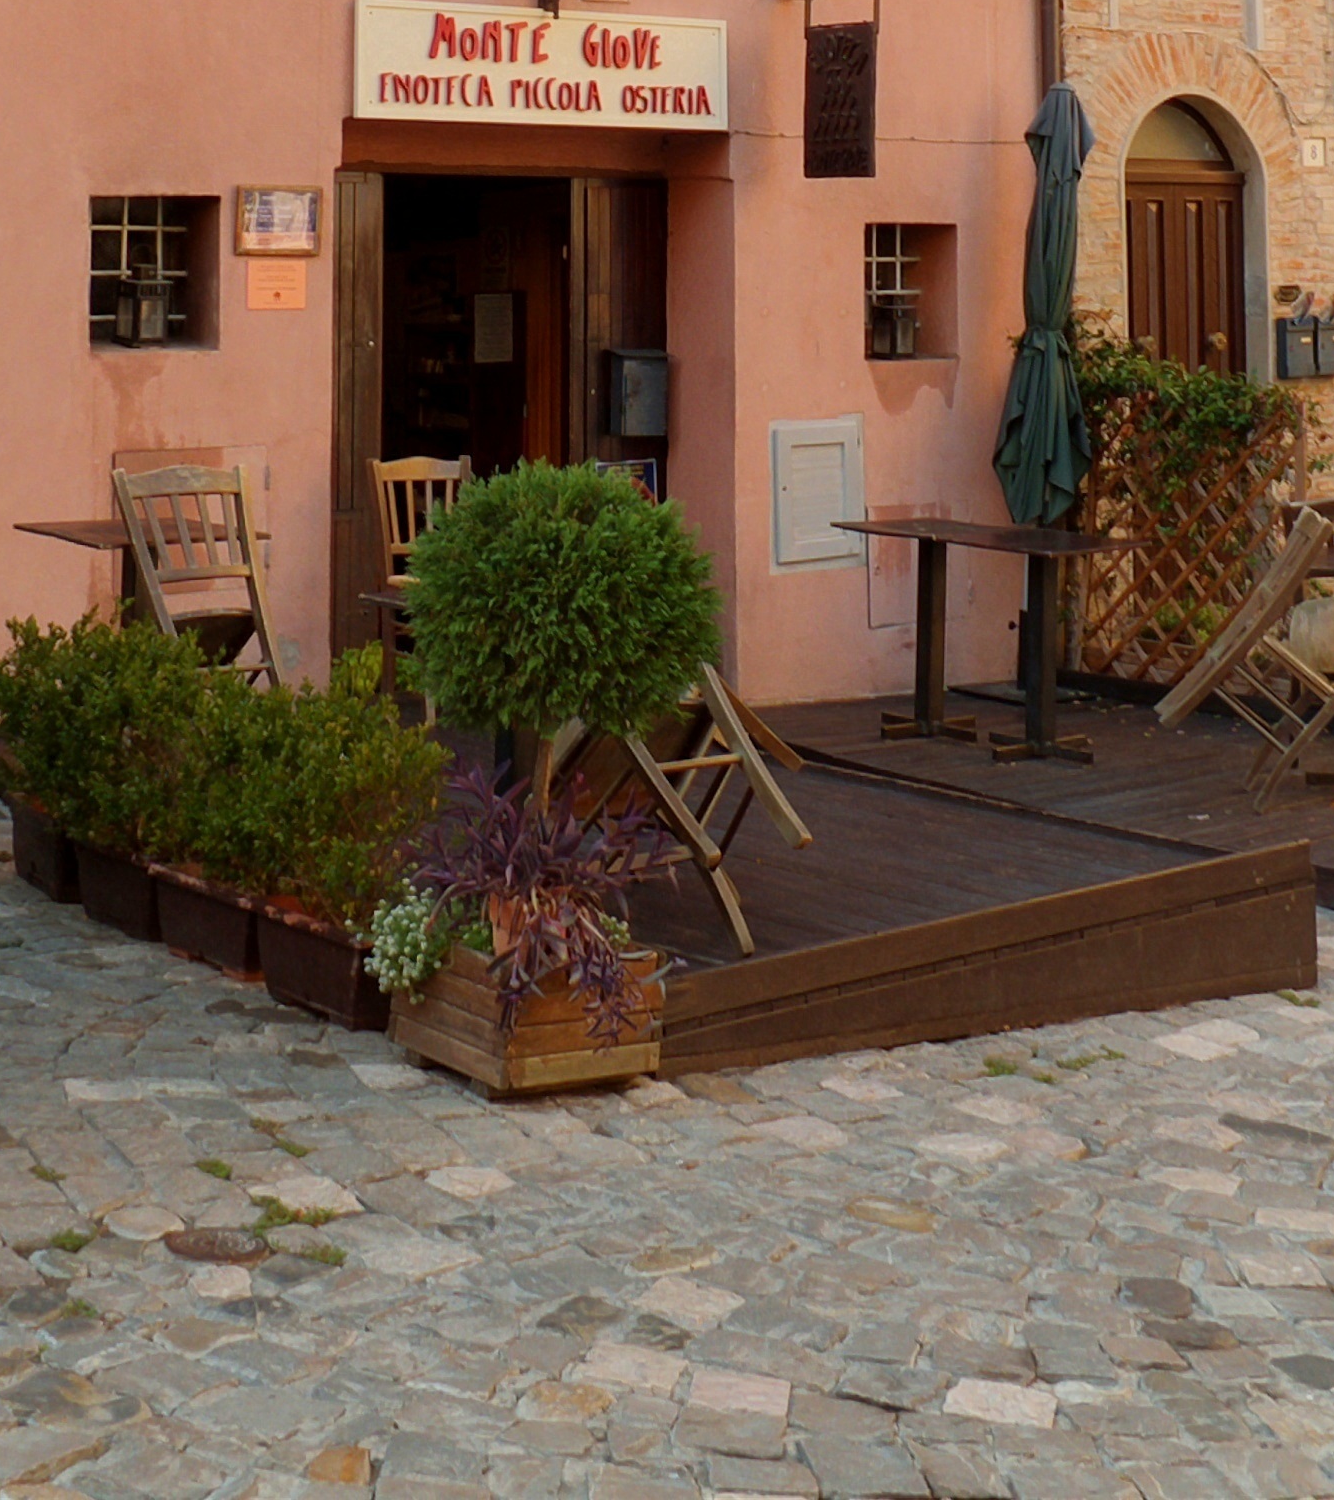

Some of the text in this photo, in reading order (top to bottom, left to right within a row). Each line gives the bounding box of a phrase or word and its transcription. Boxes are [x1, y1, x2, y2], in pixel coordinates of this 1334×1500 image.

[429, 12, 663, 70] MONTE GIOVE
[380, 71, 713, 116] ENOTECA PICCOLA OSTERIA
